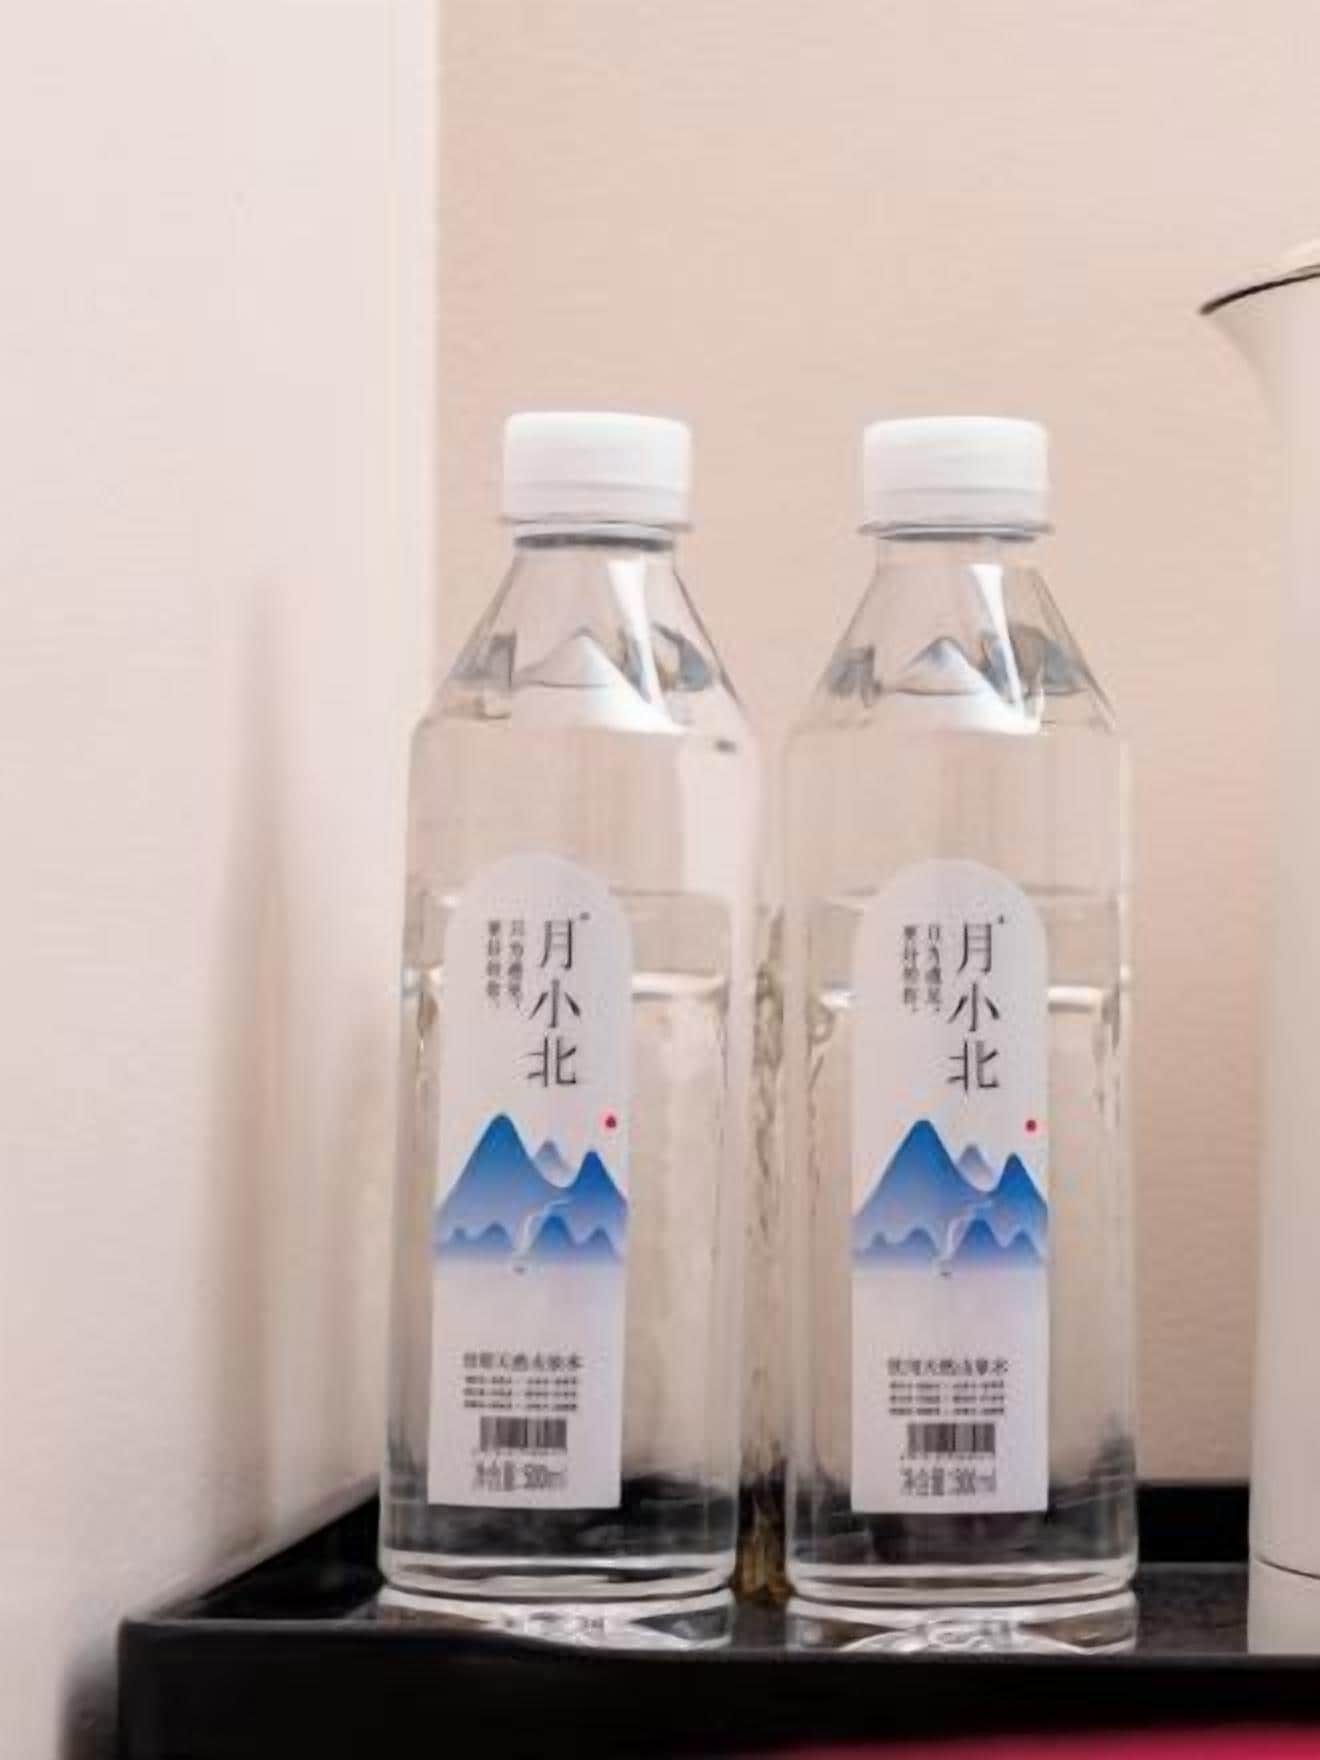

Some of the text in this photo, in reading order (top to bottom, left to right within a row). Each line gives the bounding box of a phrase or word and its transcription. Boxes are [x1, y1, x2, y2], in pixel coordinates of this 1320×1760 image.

[528, 917, 581, 1088] 月小北
[946, 922, 1000, 1092] 月小北
